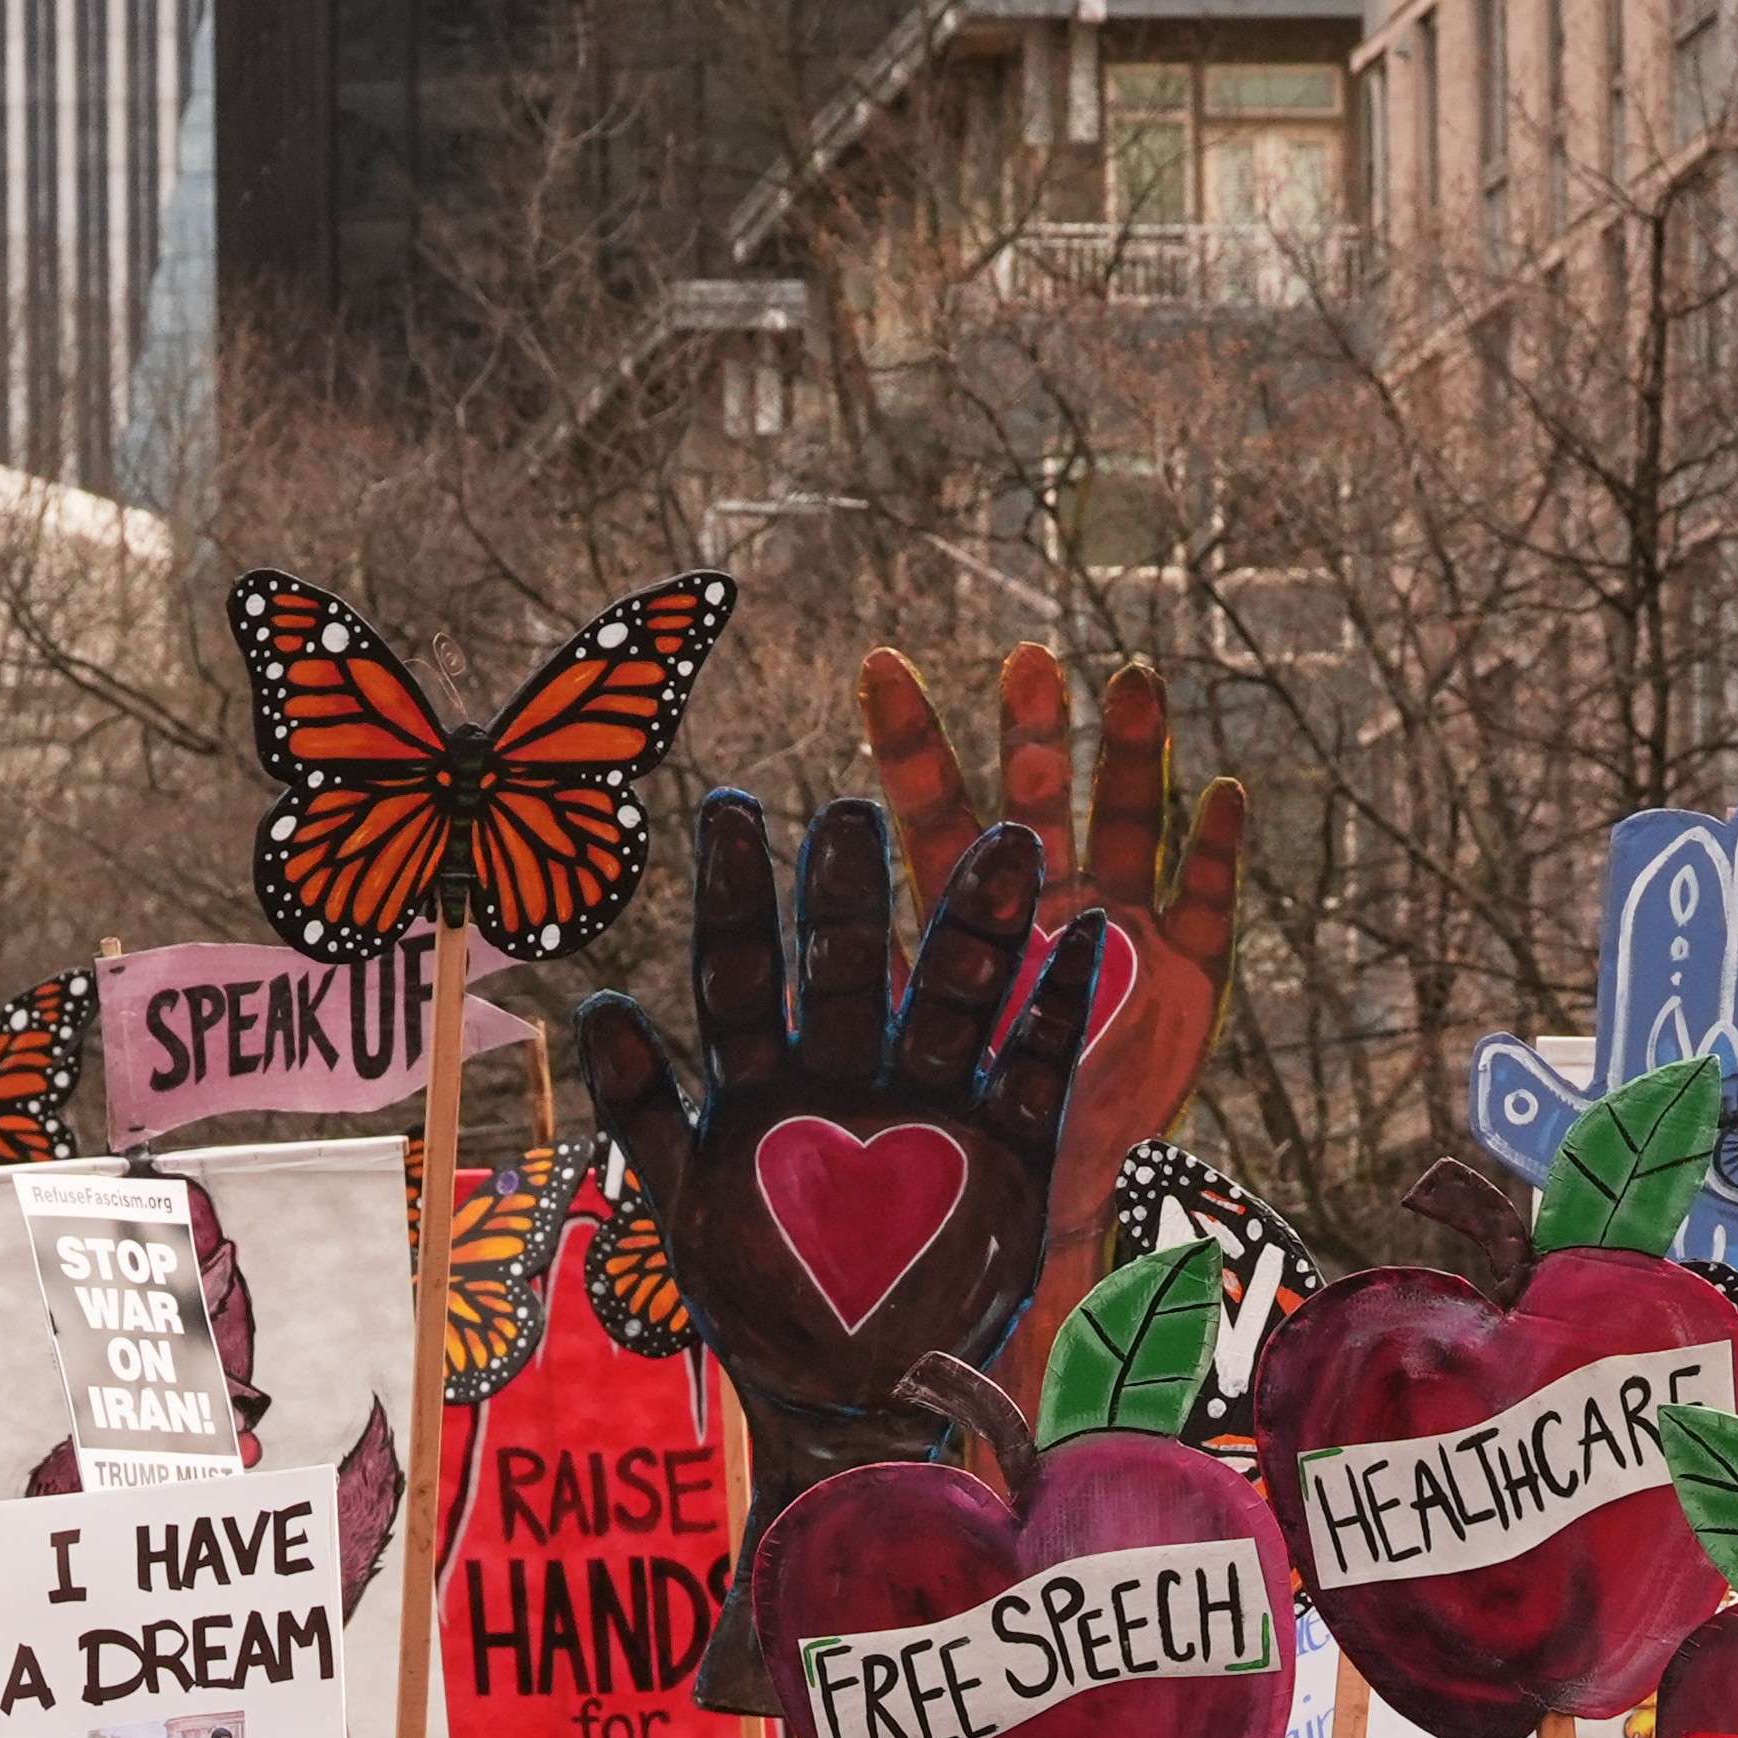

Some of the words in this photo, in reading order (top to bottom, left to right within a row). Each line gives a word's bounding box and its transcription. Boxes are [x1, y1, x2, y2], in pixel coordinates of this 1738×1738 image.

[146, 966, 340, 1093] SPEAK
[31, 1185, 174, 1214] RefuseFascism.org
[56, 1235, 178, 1285] STOP
[74, 1286, 186, 1335] WAR
[106, 1336, 178, 1384] ON
[87, 1385, 217, 1436] IRAN!
[94, 1461, 170, 1487] TRUMP
[497, 1446, 716, 1545] RAISE
[48, 1528, 87, 1604] I
[135, 1500, 315, 1592] HAVE
[991, 1558, 1246, 1702] SPEECH
[0, 1642, 57, 1717] A
[77, 1604, 335, 1706] DREAM
